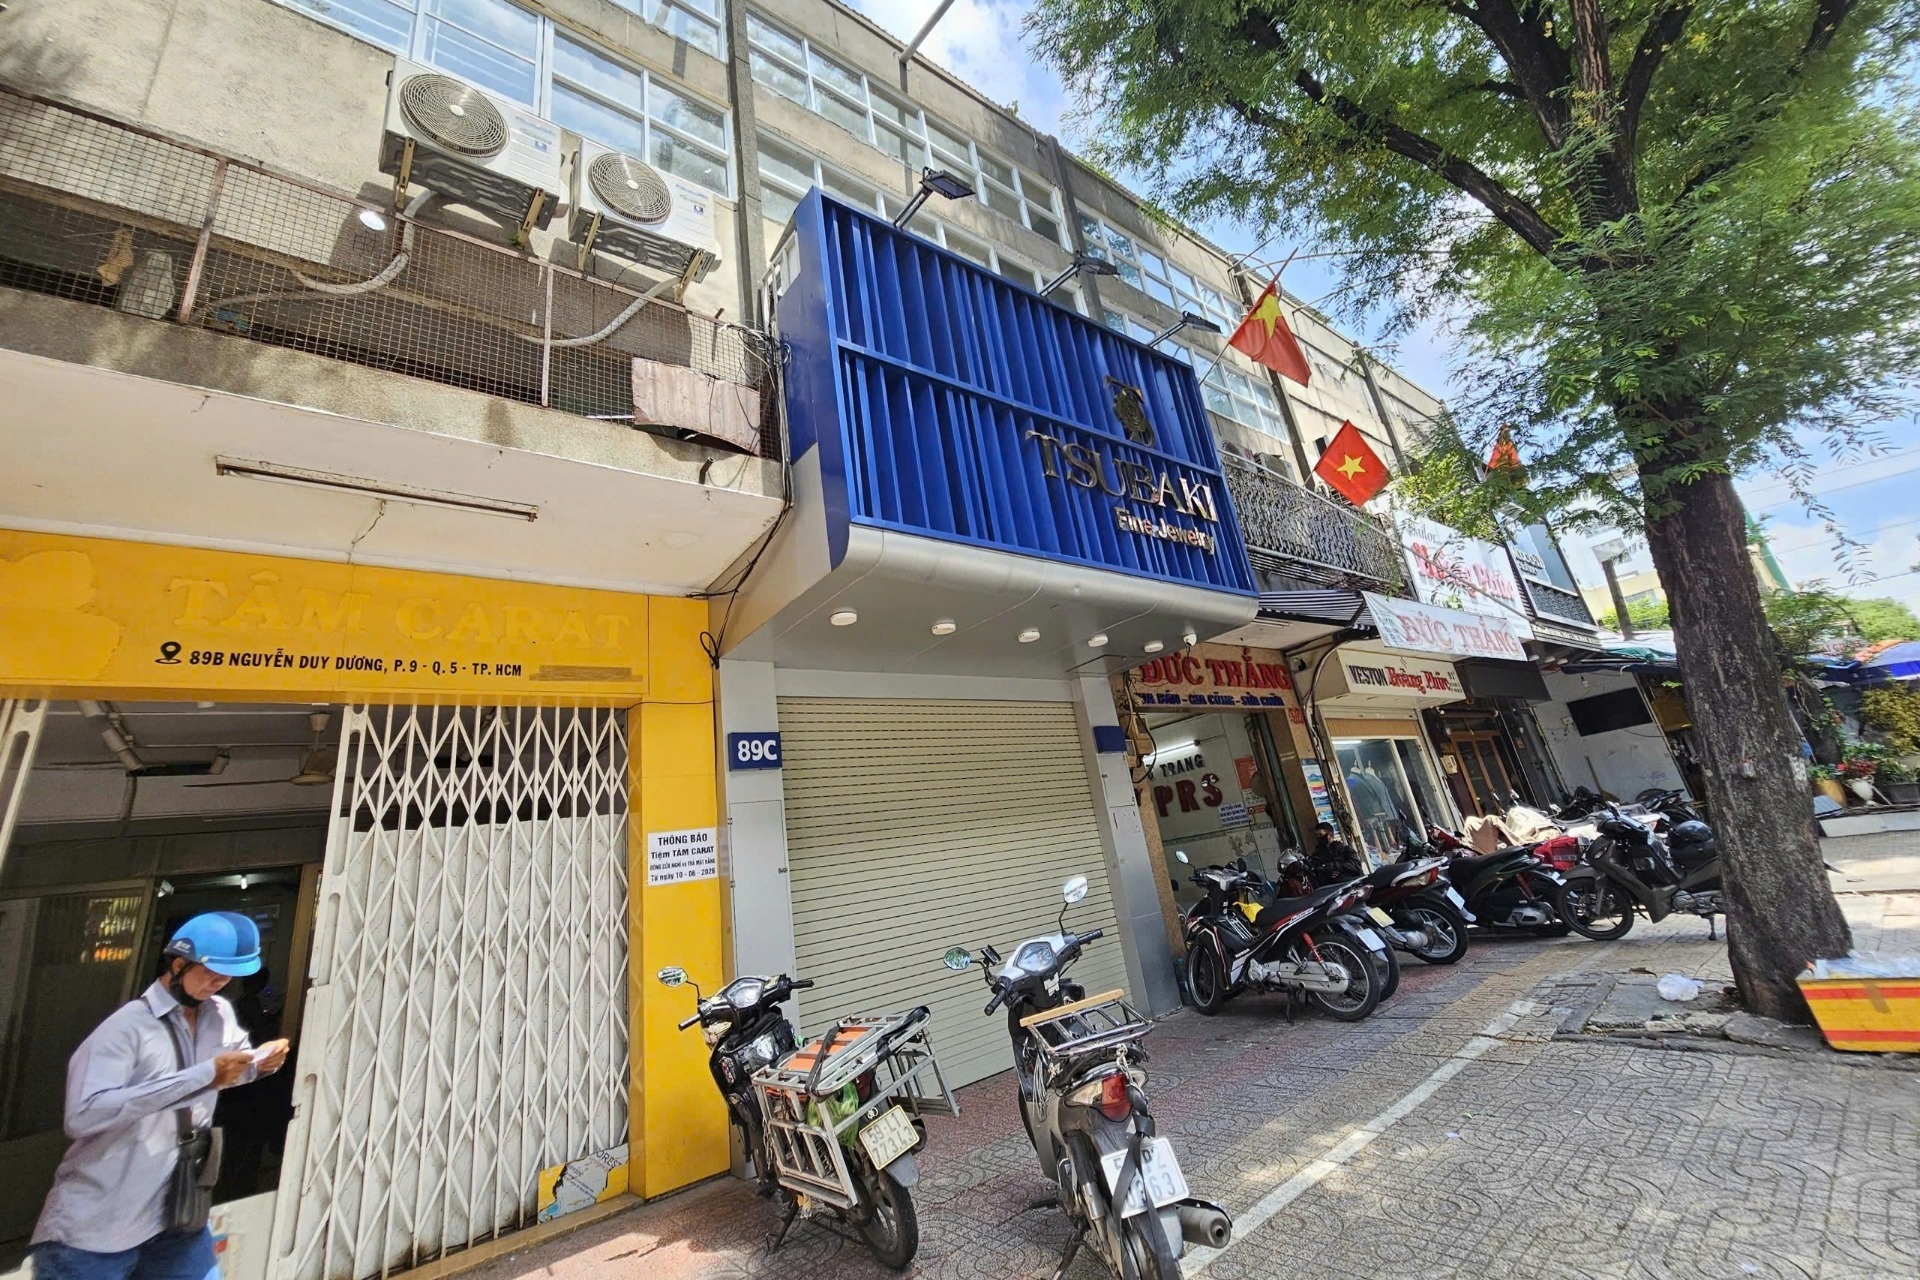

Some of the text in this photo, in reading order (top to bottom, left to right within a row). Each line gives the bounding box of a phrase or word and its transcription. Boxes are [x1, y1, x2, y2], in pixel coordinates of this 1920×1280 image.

[1025, 430, 1218, 523] TSUBAKI
[1114, 507, 1215, 555] Fine Jewelry
[164, 569, 631, 650] TÂM CARAT
[1396, 610, 1453, 651] ĐỨC
[1453, 616, 1520, 657] THẮNG
[189, 650, 225, 666] 89B
[229, 647, 294, 668] NGUYỄN
[299, 655, 330, 669] DUY
[335, 655, 388, 675] DƯƠNG,
[1206, 648, 1292, 690] THẮNG
[1348, 665, 1389, 686] VESTON
[737, 740, 778, 762] 89C
[1160, 753, 1205, 777] TRANG
[1154, 773, 1223, 817] PRS
[651, 846, 714, 860] Tiệm TÂM CARAT
[658, 831, 708, 846] THÔNG BÁO
